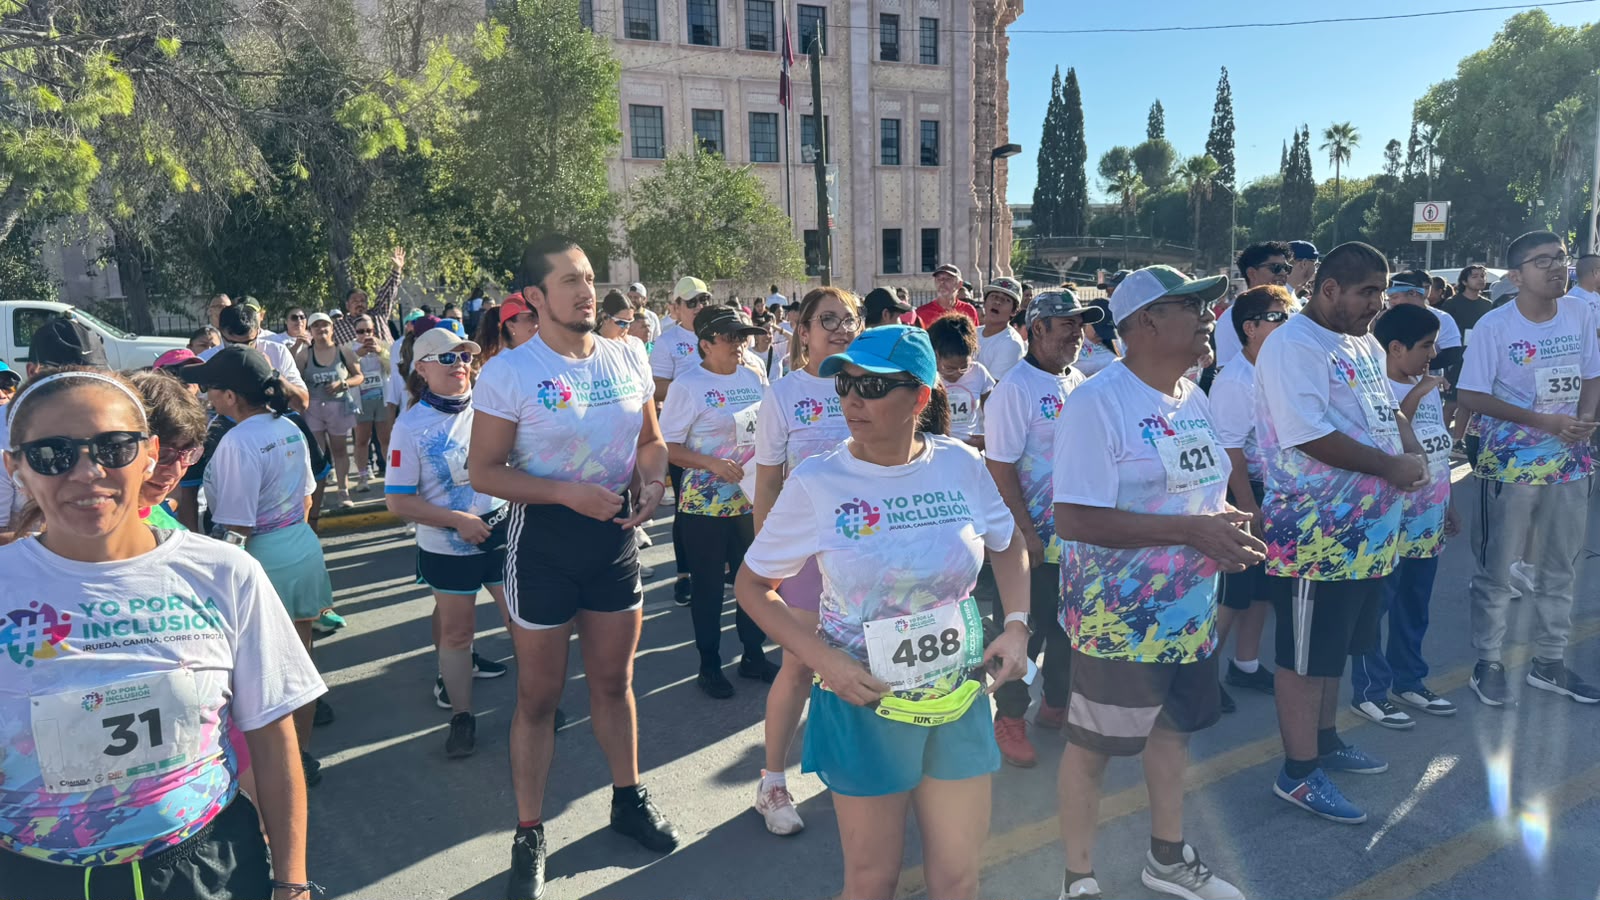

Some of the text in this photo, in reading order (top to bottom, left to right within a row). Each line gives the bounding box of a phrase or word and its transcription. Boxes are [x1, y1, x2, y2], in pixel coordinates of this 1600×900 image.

[1538, 339, 1552, 347] YO
[1554, 335, 1574, 344] POR
[574, 375, 632, 390] YO POR LA
[1548, 376, 1581, 393] 330
[1422, 434, 1451, 454] 328
[1180, 445, 1215, 472] 421
[882, 490, 966, 510] YO POR LA
[886, 502, 971, 524] INCLUSIÓN
[78, 594, 219, 618] YO POR LA
[83, 641, 122, 652] ¡RUEDA,
[122, 637, 162, 647] CAMINA,
[163, 633, 192, 643] CORRE
[193, 633, 200, 641] O
[892, 628, 960, 668] 488
[102, 707, 163, 757] 31
